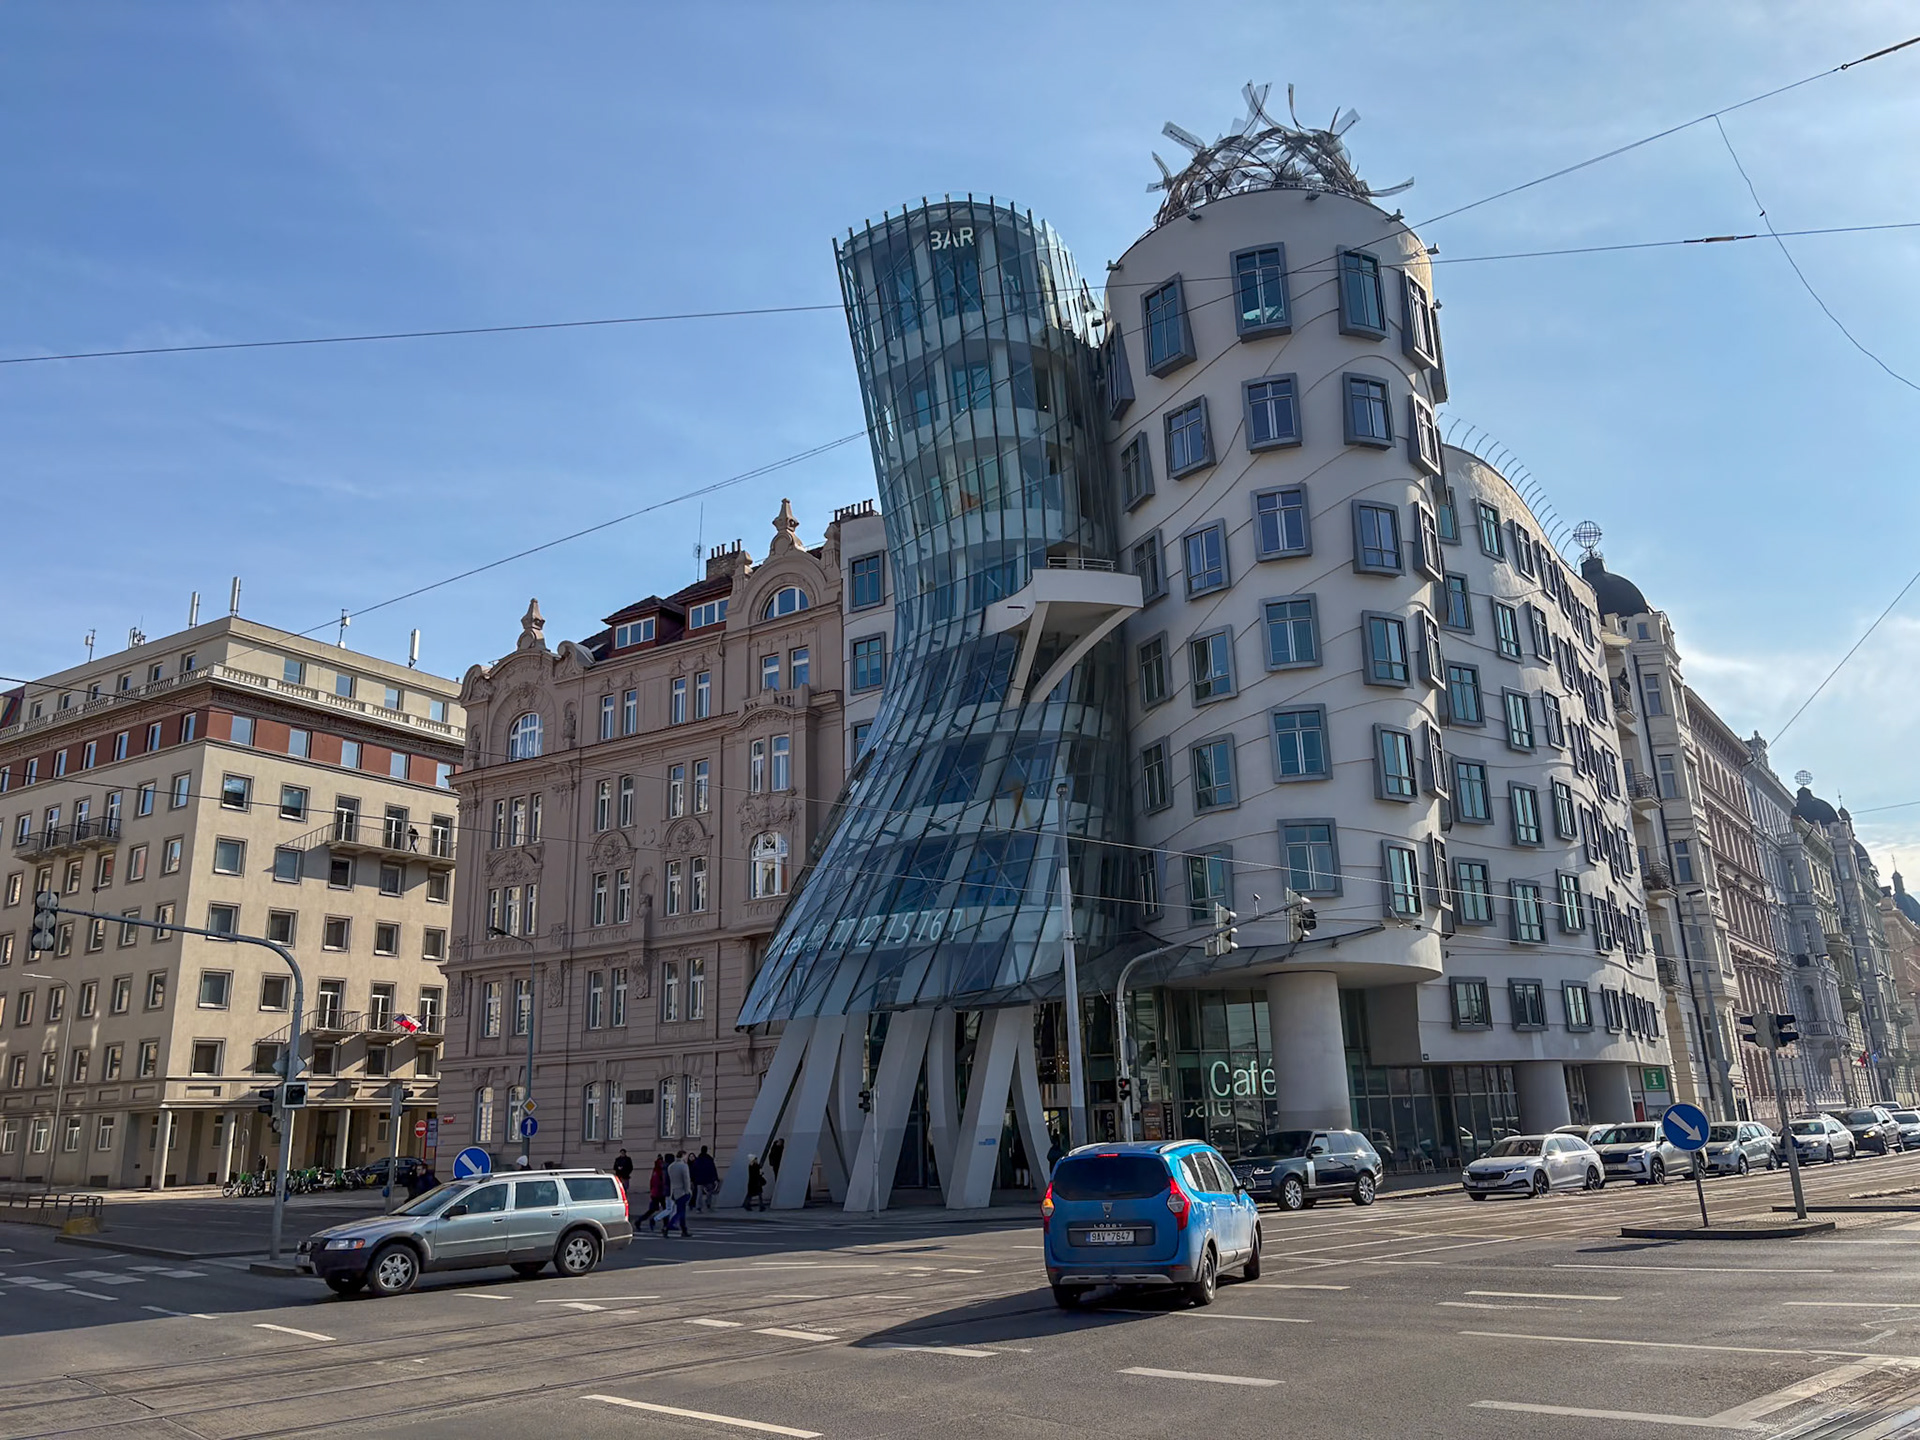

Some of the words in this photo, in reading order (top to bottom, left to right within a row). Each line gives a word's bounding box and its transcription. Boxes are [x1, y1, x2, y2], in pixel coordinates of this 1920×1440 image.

[930, 226, 975, 250] BAR
[1210, 1058, 1277, 1096] Café
[1106, 1112, 1115, 1142] GLAS
